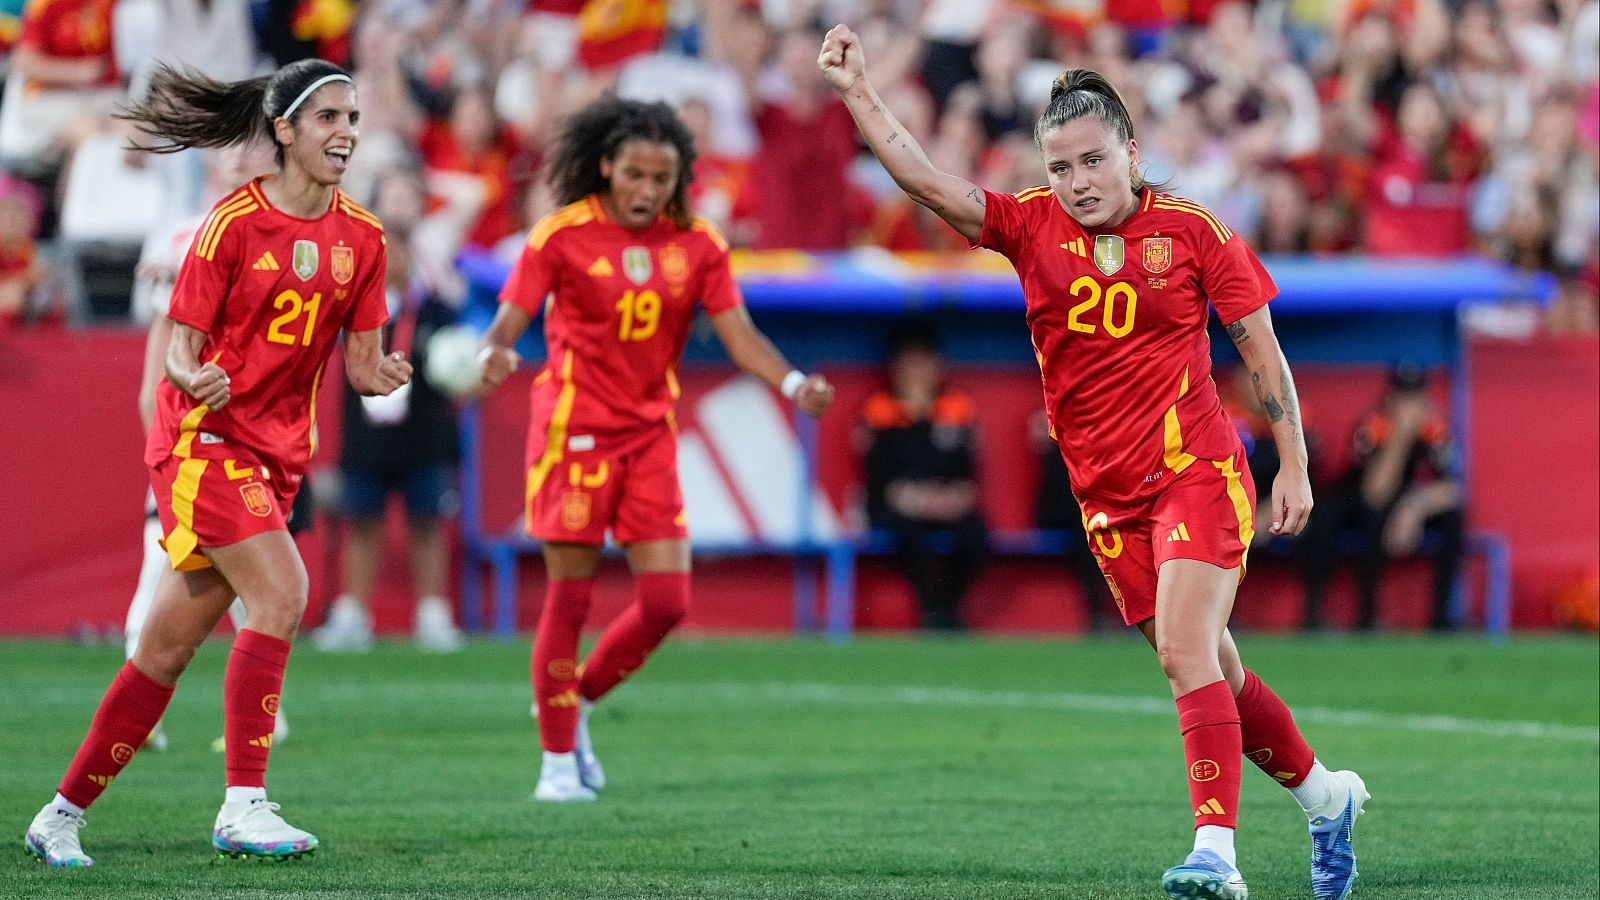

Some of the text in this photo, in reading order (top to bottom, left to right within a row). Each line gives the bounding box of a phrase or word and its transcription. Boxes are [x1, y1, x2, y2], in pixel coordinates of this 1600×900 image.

[267, 289, 322, 347] 21
[615, 289, 662, 342] 19
[1067, 275, 1138, 339] 20
